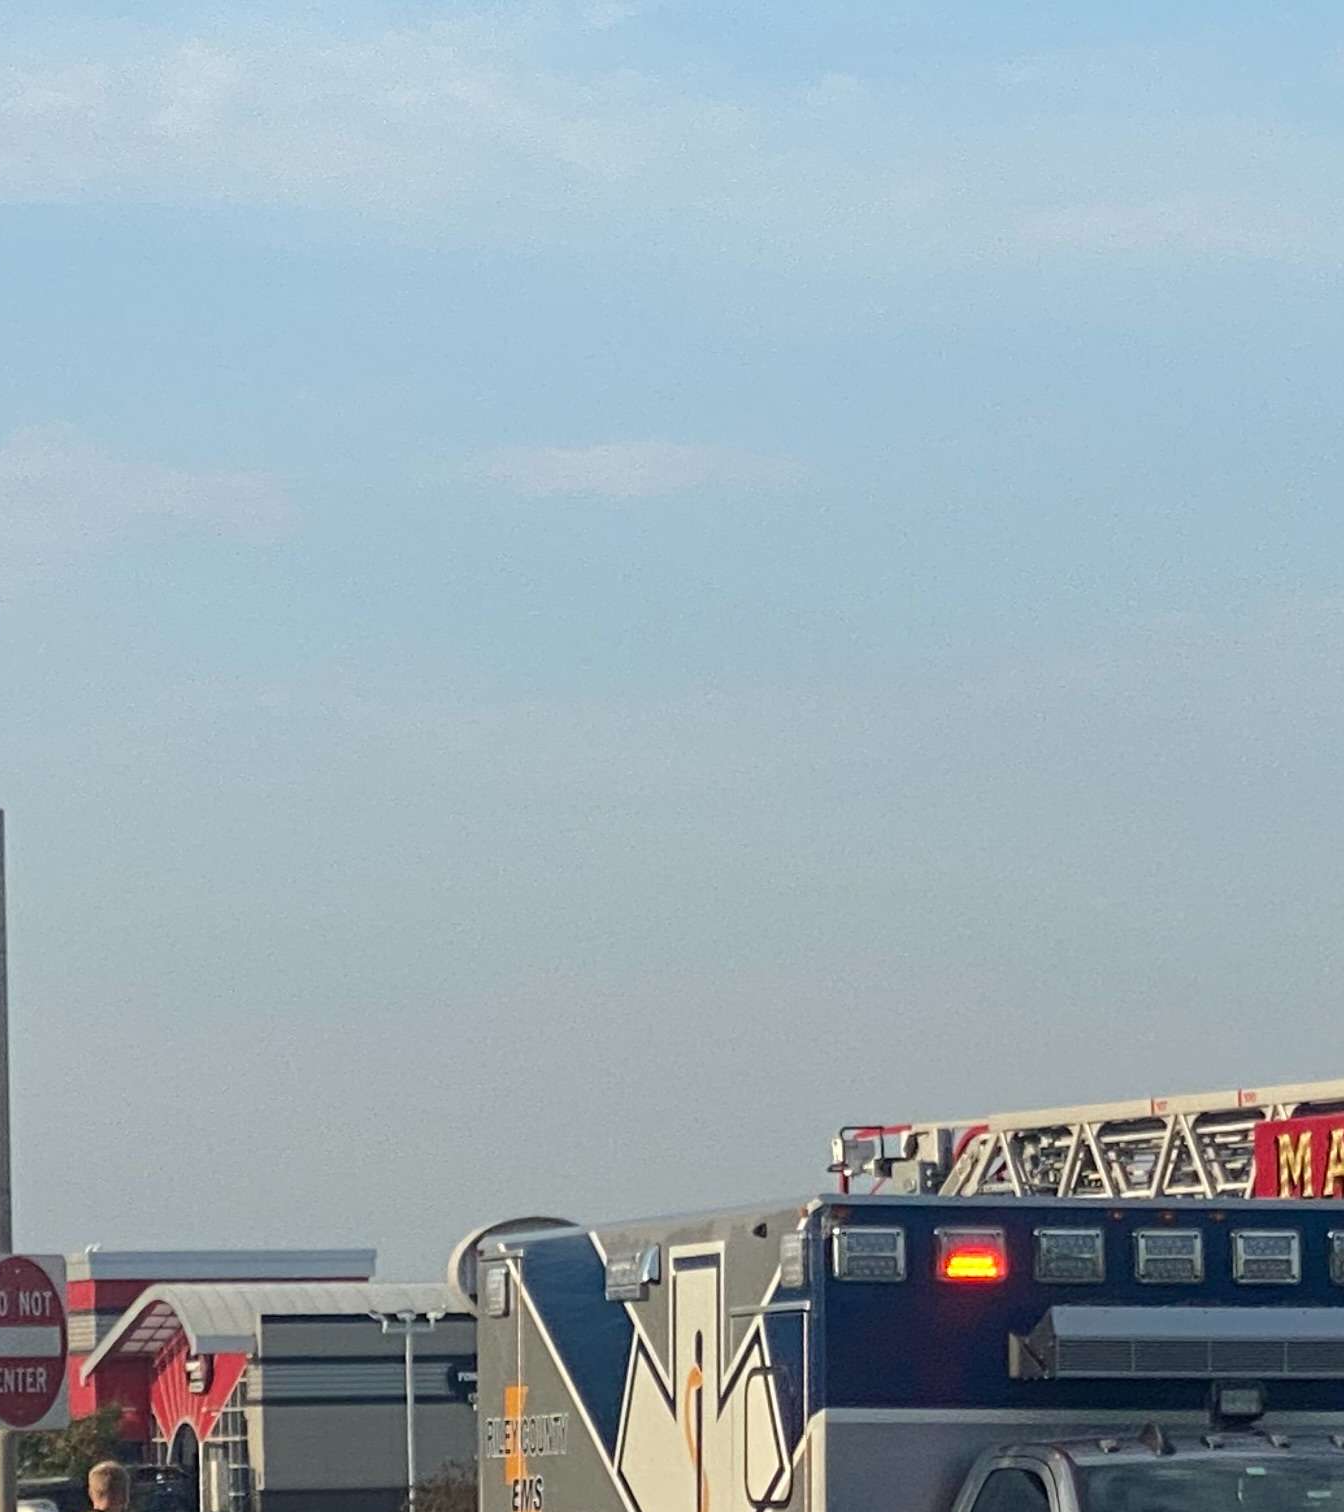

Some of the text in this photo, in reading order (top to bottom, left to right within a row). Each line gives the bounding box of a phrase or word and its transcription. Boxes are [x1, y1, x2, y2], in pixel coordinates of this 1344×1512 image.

[19, 1291, 52, 1316] NOT
[487, 1413, 569, 1458] RILEY COUNTY
